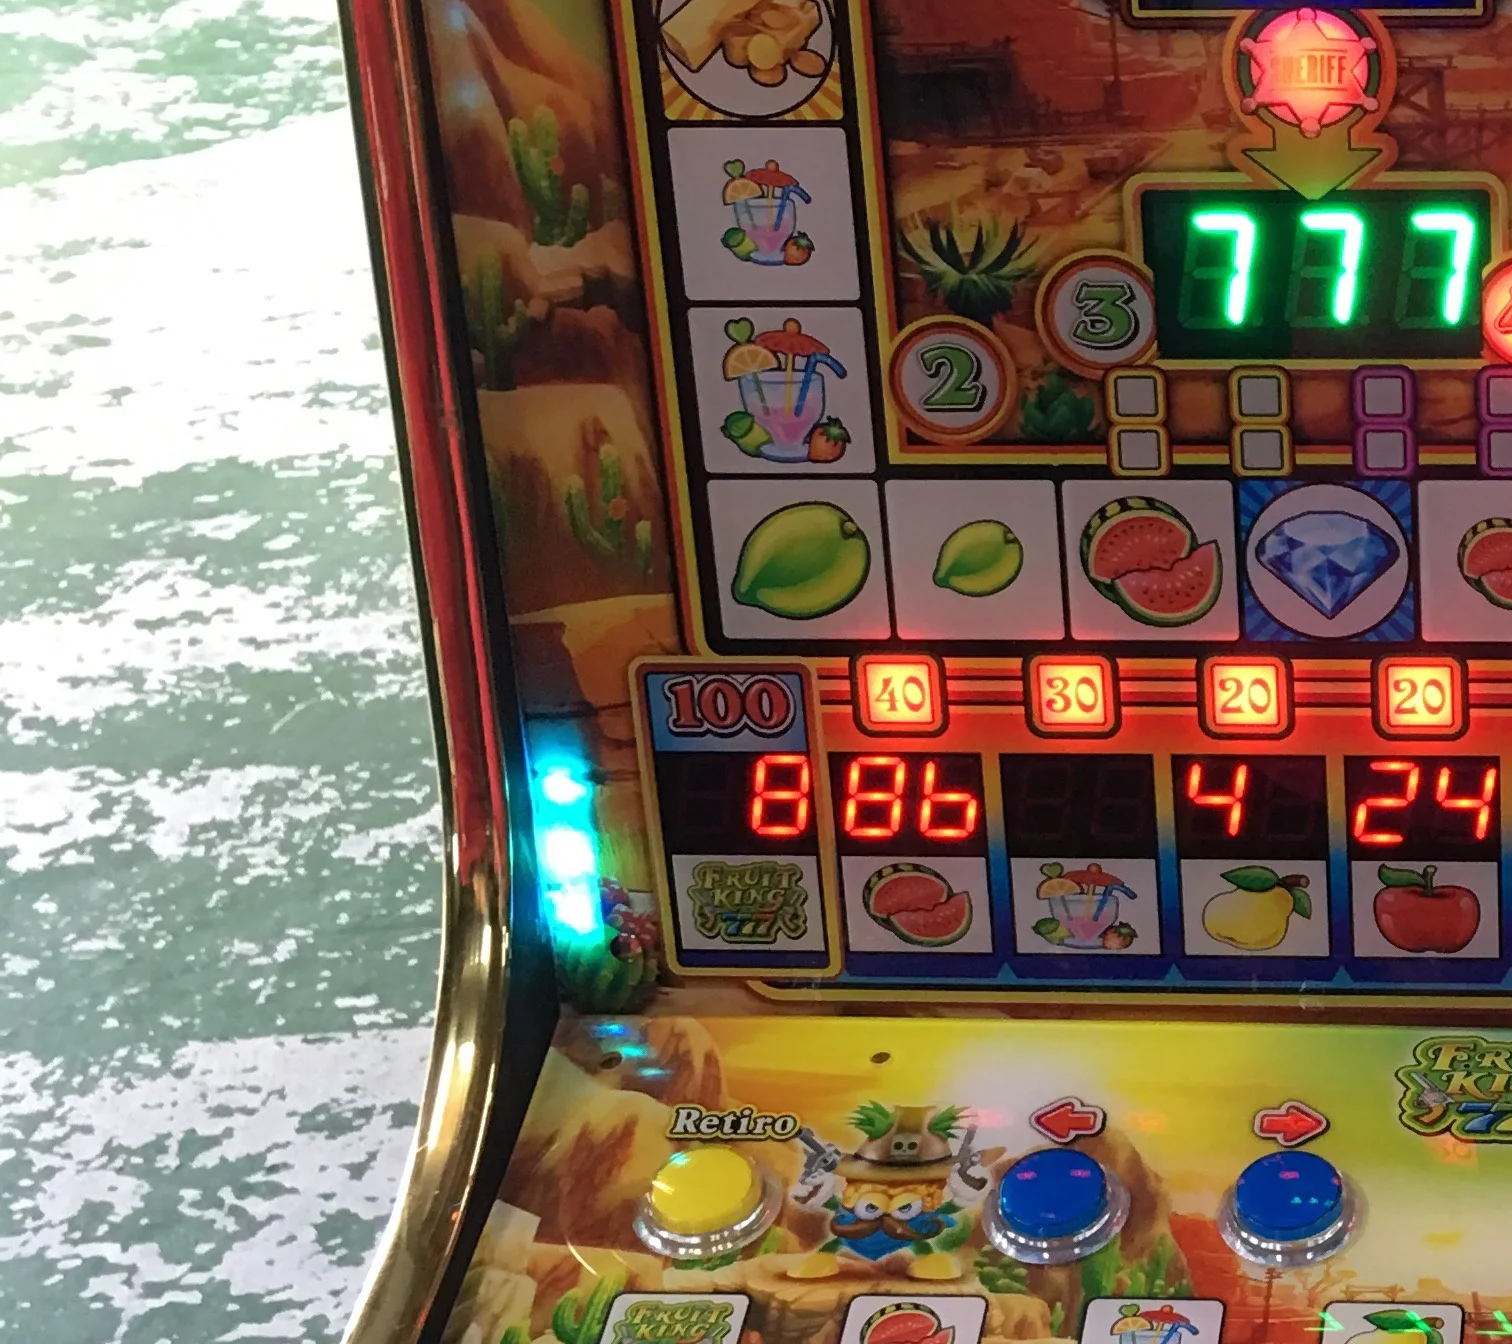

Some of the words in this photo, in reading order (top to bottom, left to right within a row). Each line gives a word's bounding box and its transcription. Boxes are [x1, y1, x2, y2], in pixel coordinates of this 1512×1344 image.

[1193, 211, 1478, 326] 777
[1072, 281, 1135, 346] 3
[921, 346, 984, 411] 2
[668, 677, 793, 732] 100
[874, 675, 926, 714] 40
[1045, 675, 1100, 714] 30
[1218, 675, 1271, 714] 20
[1392, 677, 1447, 717] 20
[751, 754, 811, 836] 8
[1187, 762, 1248, 837] 4
[1353, 761, 1497, 844] 24
[670, 1107, 798, 1141] Retiro
[630, 1306, 724, 1325] FRUIT
[635, 1323, 710, 1344] KING
